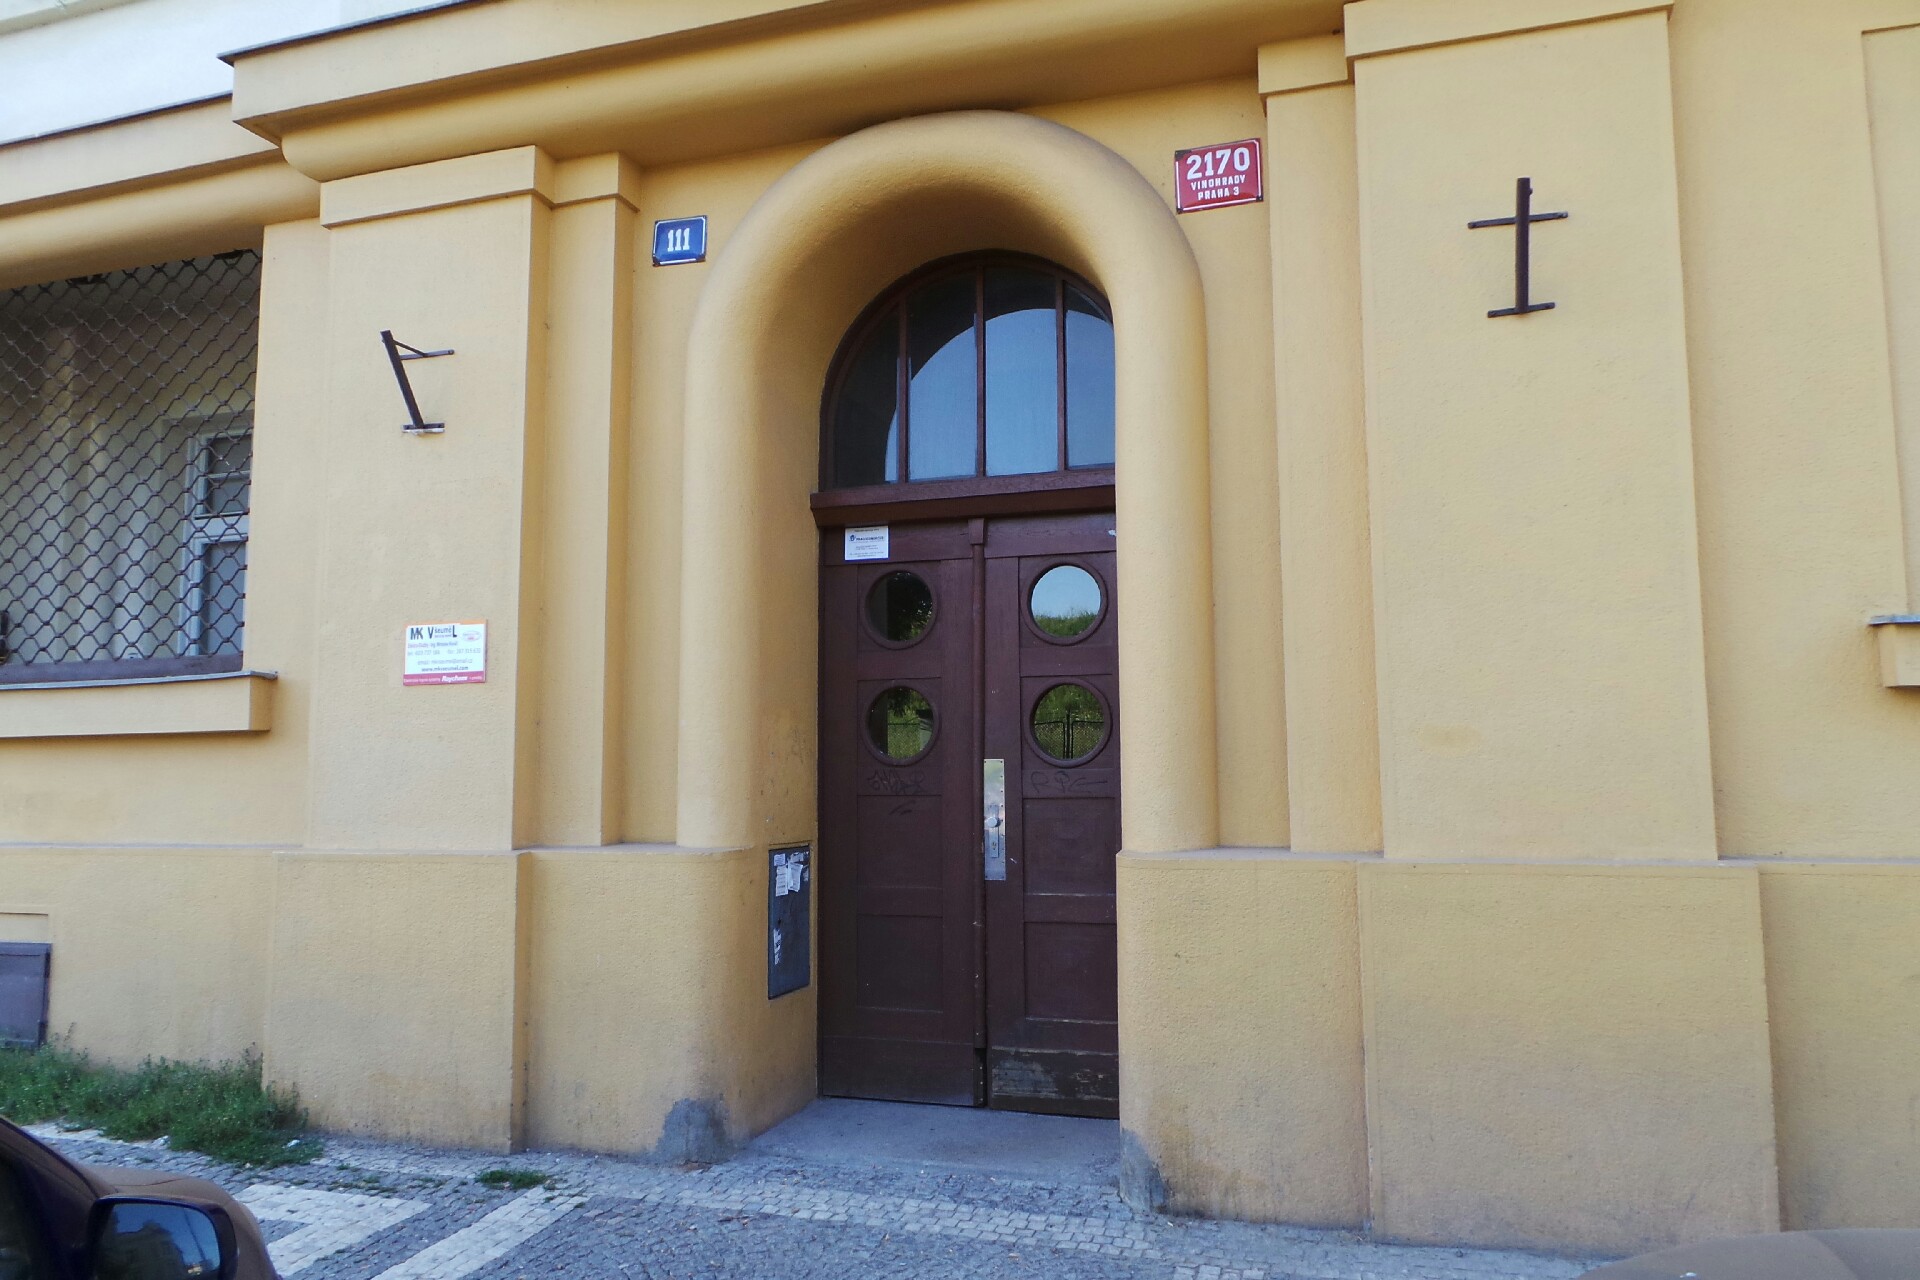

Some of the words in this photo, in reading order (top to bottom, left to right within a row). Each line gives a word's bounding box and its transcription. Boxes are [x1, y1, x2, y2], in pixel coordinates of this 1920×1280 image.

[1186, 147, 1250, 180] 2170
[1190, 174, 1246, 191] VINOHRADY
[1197, 187, 1230, 201] PRAHA
[1233, 186, 1240, 196] 3
[667, 227, 690, 252] 111
[410, 627, 424, 640] MK
